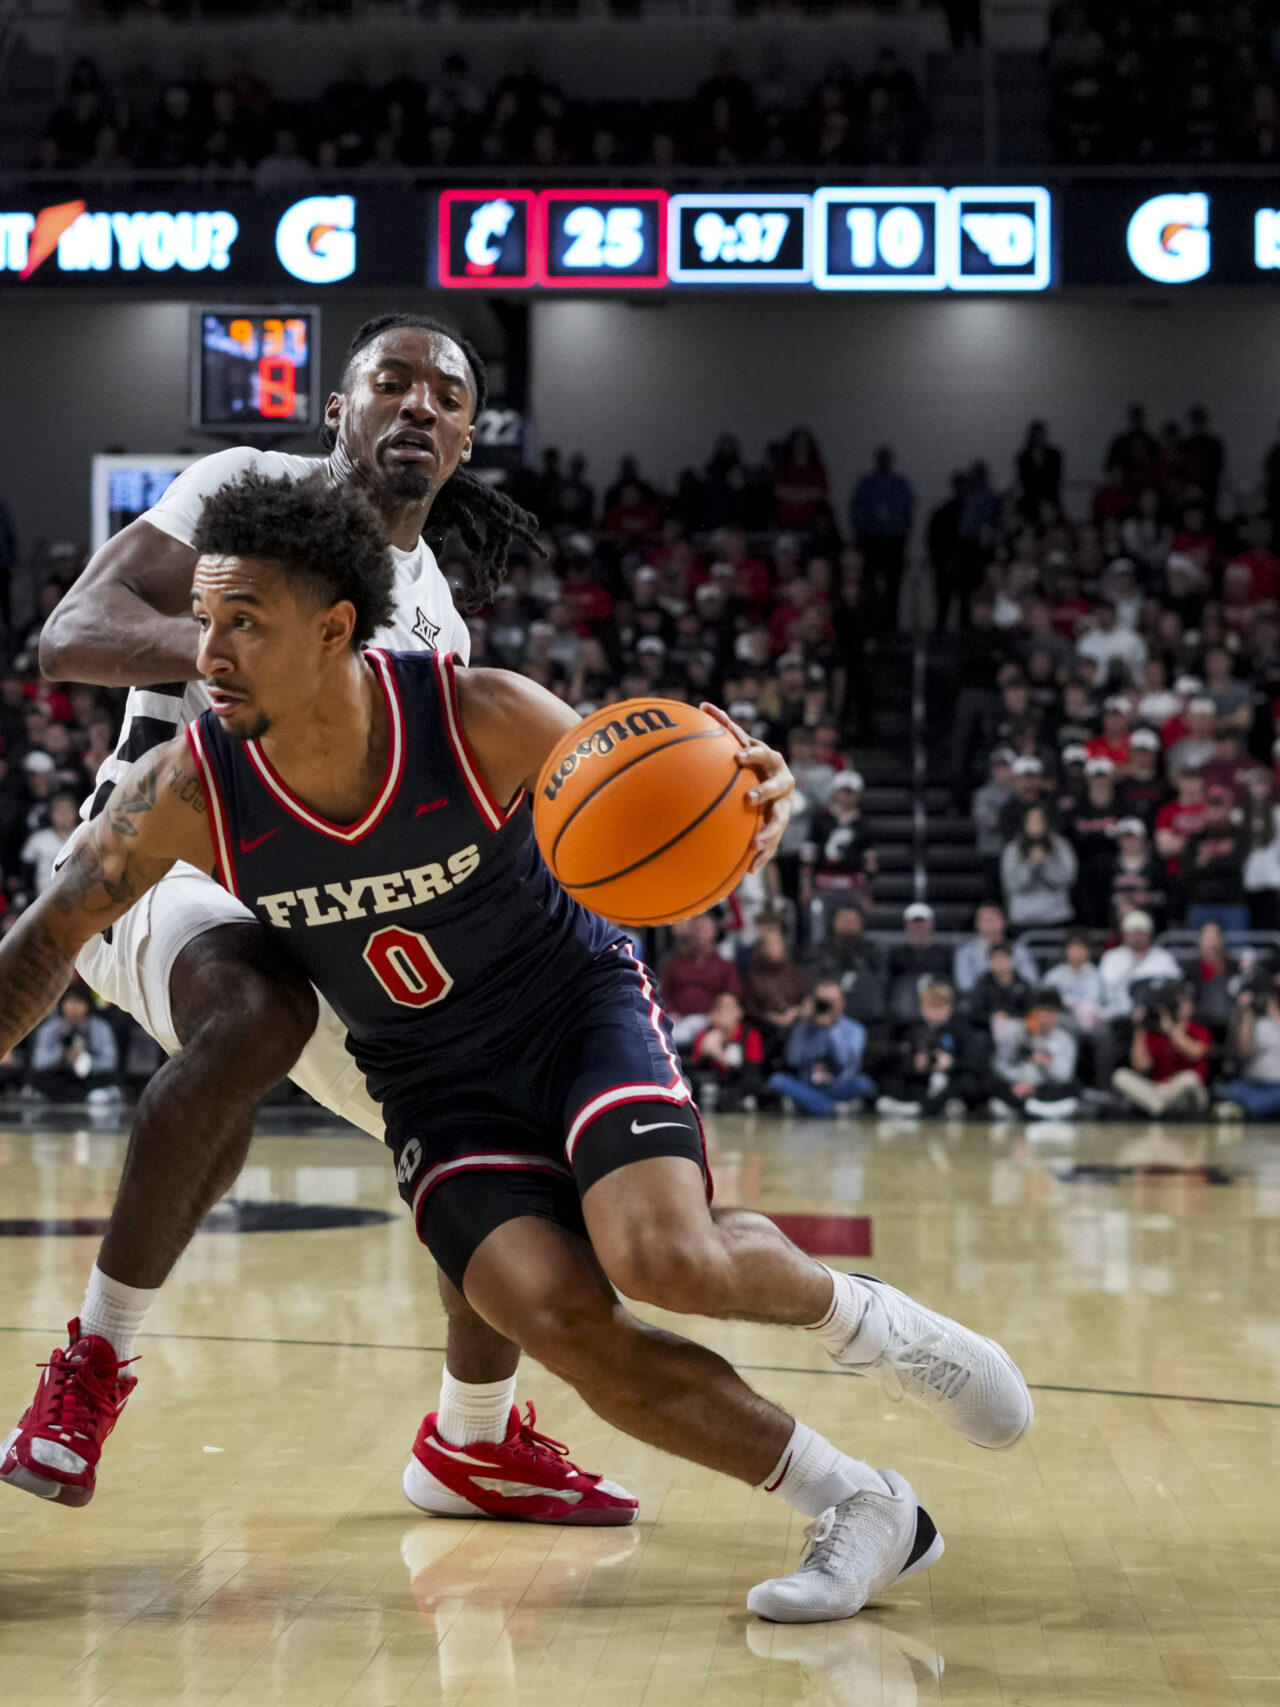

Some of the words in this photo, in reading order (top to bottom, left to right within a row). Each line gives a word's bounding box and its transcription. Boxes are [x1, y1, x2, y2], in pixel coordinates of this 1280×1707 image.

[112, 210, 239, 271] YOU?
[275, 195, 357, 283] G
[562, 206, 644, 268] 25
[693, 212, 790, 263] 9:37
[846, 206, 924, 269] 10
[1126, 192, 1210, 284] G
[258, 356, 296, 418] 8
[543, 708, 678, 802] Wilson
[257, 843, 481, 929] FLYERS
[362, 924, 455, 1009] 0
